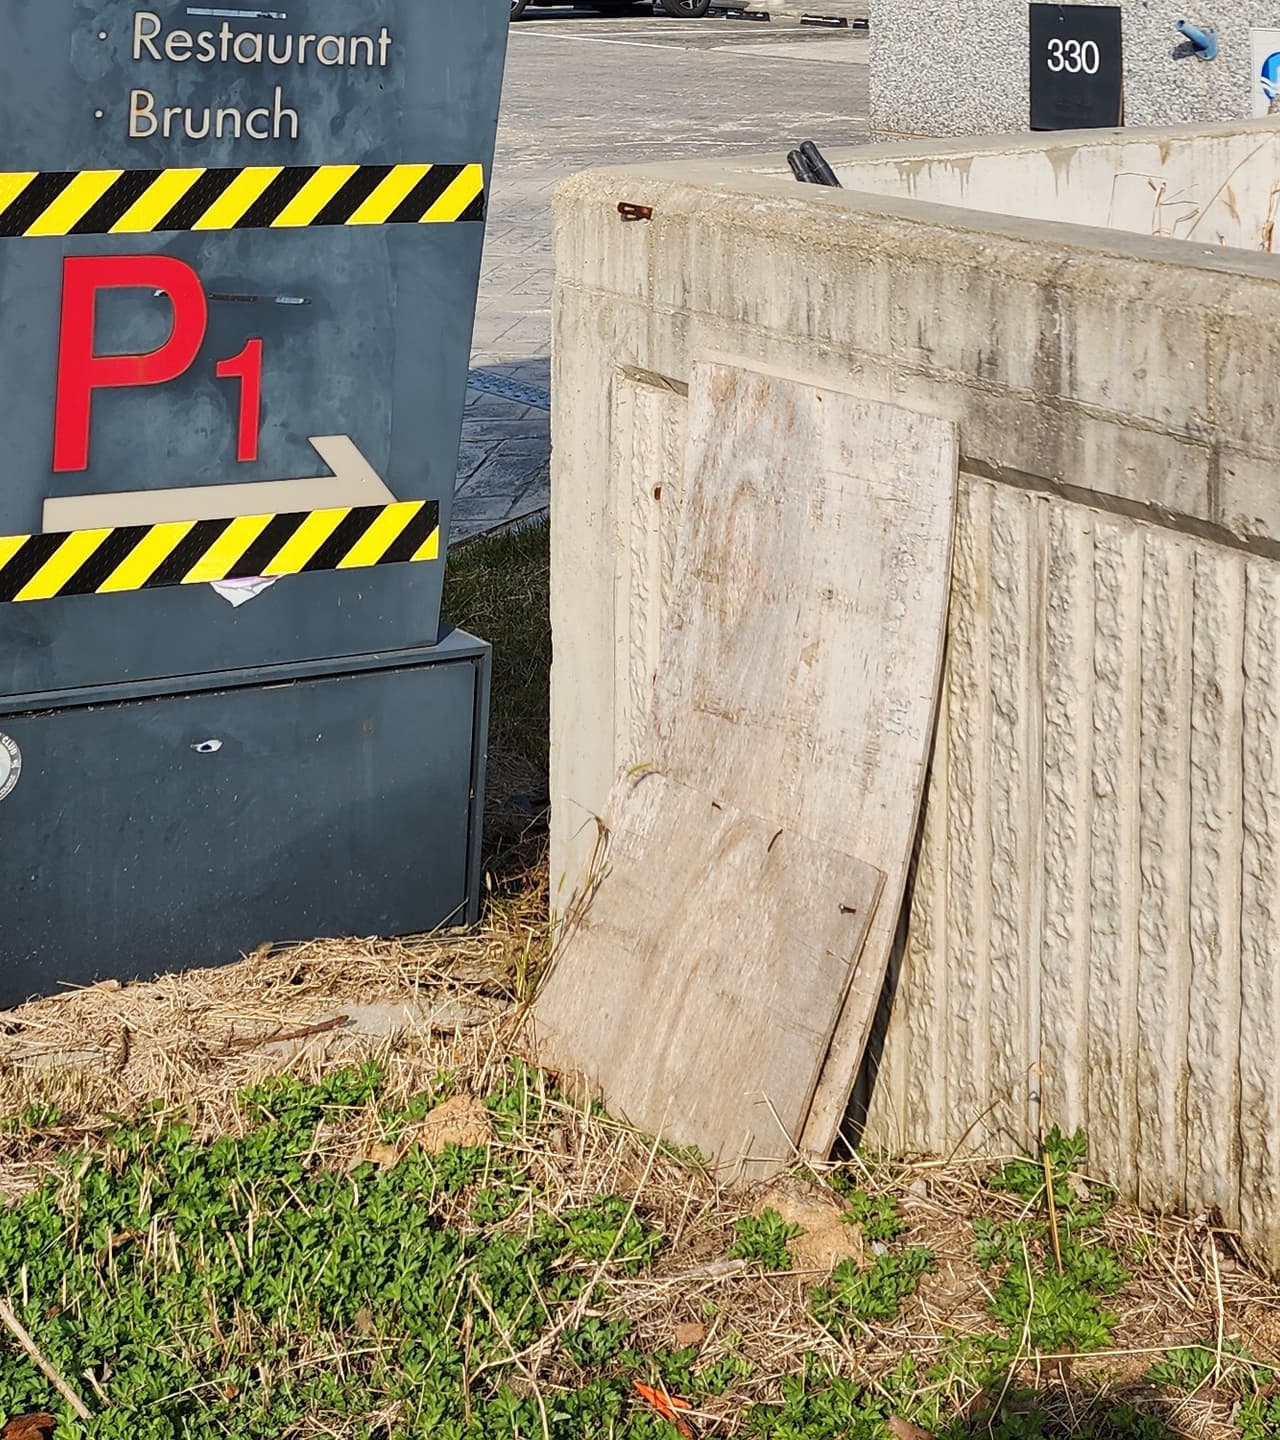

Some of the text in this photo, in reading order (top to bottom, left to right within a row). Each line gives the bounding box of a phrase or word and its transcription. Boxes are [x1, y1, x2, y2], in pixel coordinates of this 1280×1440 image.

[132, 11, 392, 66] Restaurant
[1046, 37, 1101, 75] 330
[128, 85, 299, 140] Brunch
[1, 735, 18, 755] CLUB
